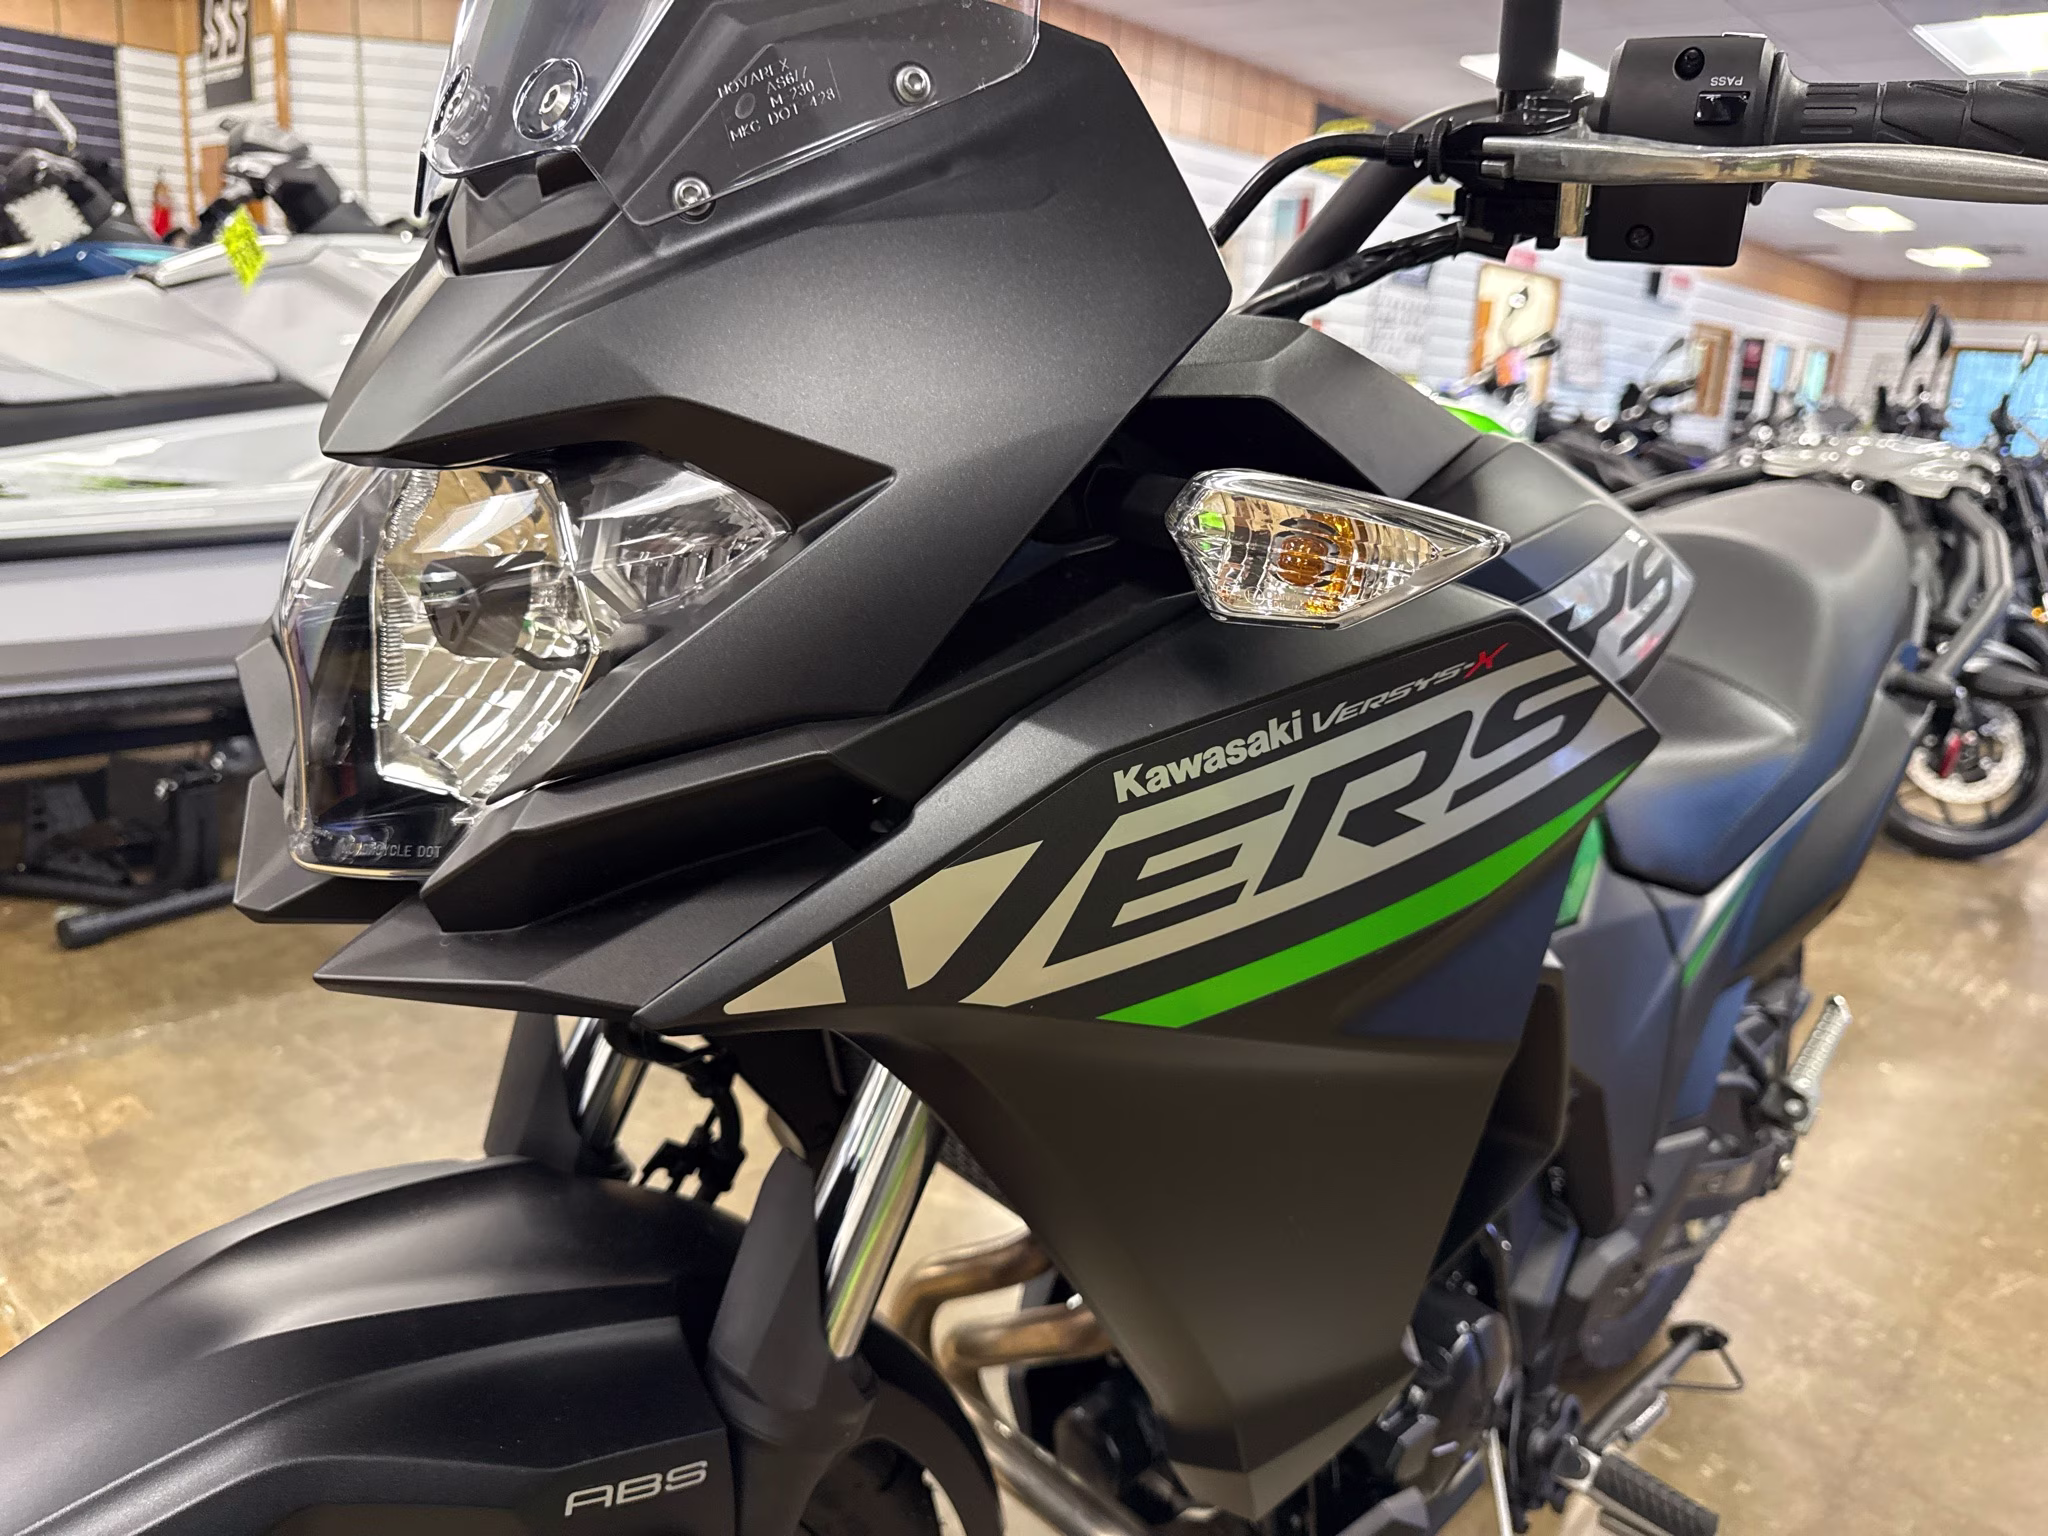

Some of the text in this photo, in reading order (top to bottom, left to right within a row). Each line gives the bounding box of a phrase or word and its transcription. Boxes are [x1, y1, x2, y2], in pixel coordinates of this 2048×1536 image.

[1710, 76, 1744, 86] PASS
[1112, 642, 1509, 804] Kawasaki VERSYS-X
[417, 845, 442, 858] DOT
[564, 1460, 708, 1516] ABS
